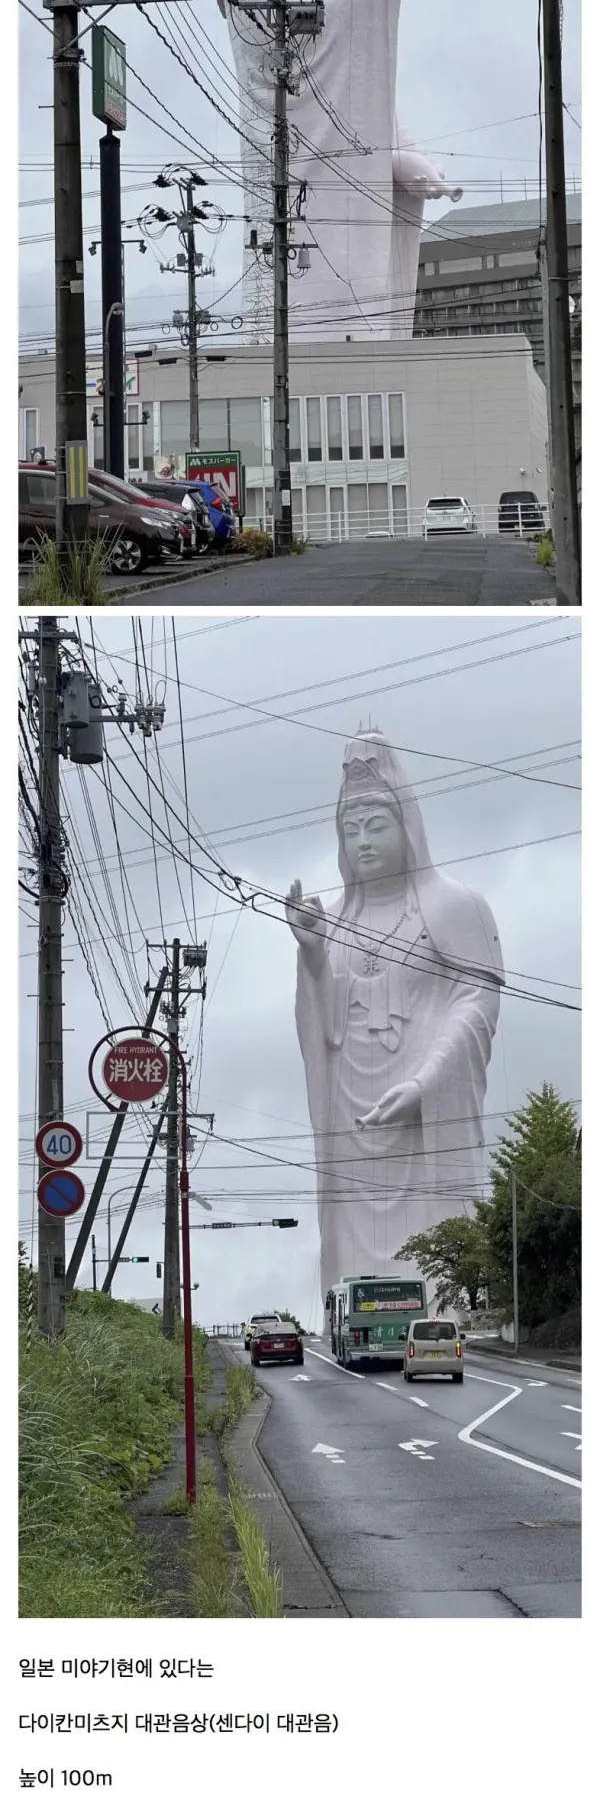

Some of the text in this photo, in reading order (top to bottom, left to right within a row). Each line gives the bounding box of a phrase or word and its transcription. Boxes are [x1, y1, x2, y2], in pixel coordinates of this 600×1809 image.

[202, 457, 236, 465] モスバーガー
[109, 1058, 163, 1082] 消火栓
[47, 1134, 72, 1155] 40
